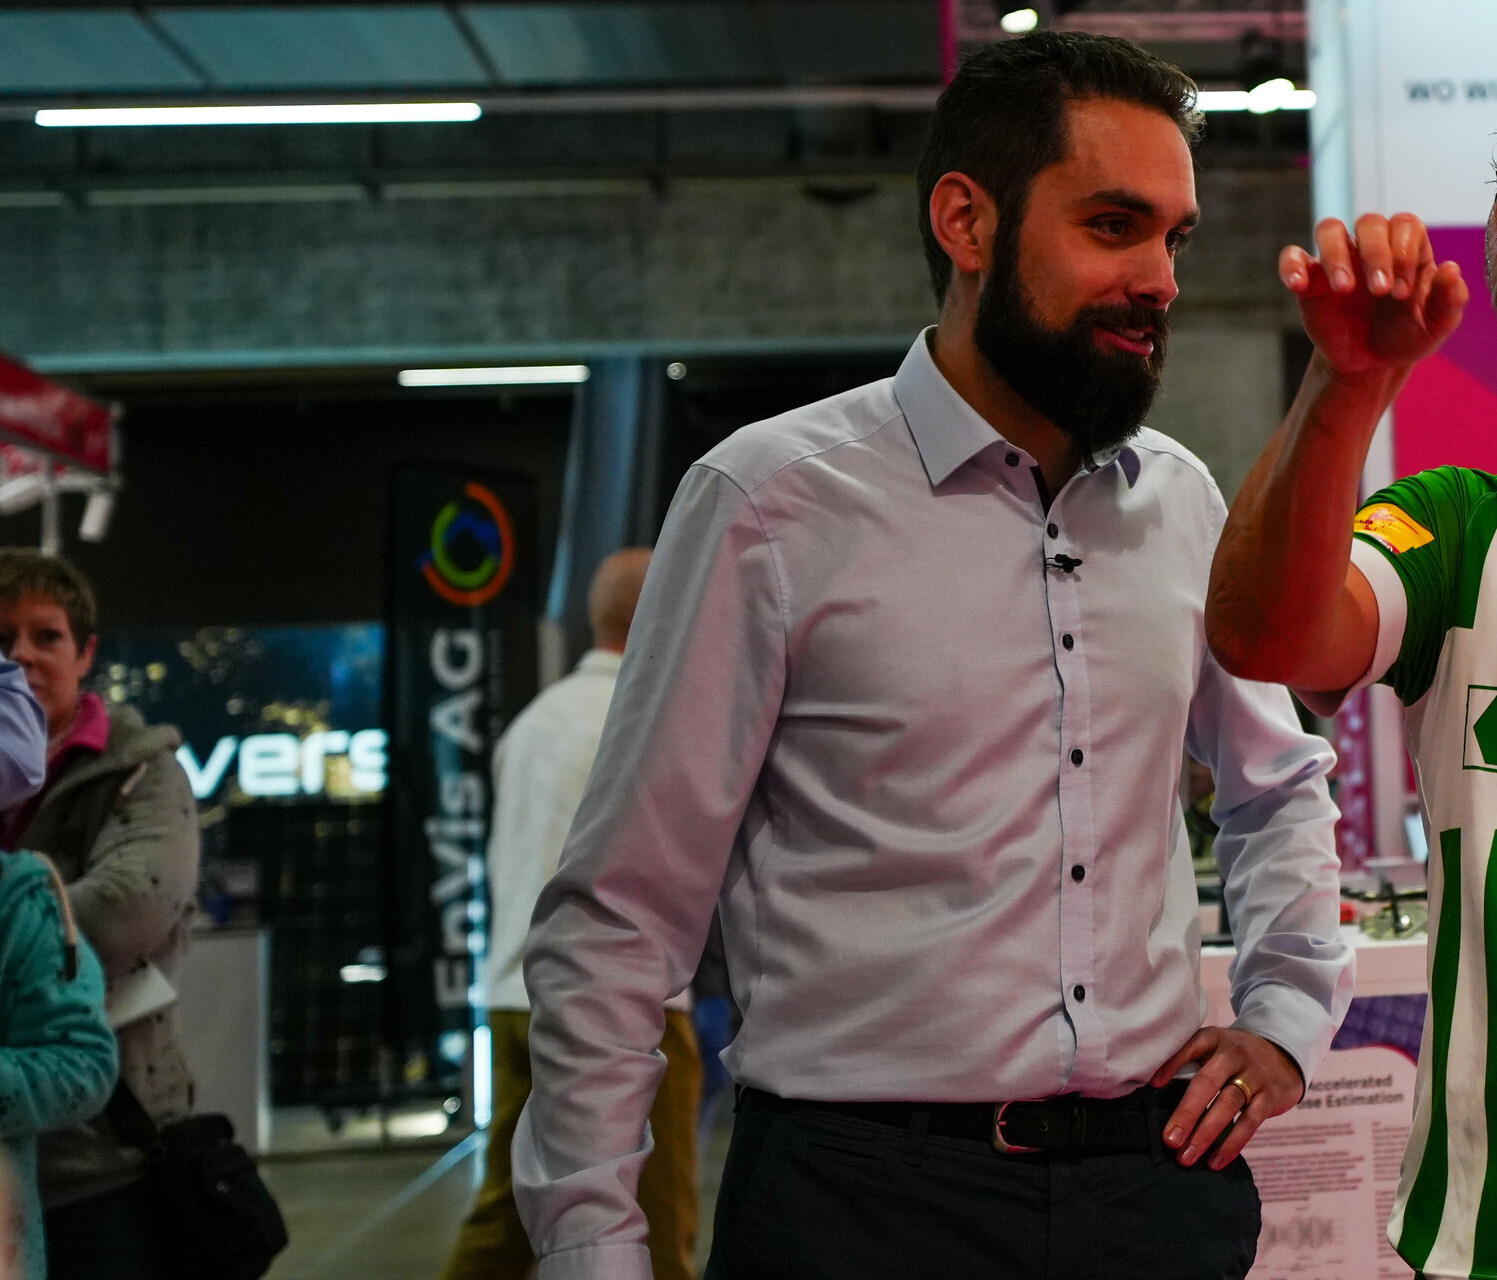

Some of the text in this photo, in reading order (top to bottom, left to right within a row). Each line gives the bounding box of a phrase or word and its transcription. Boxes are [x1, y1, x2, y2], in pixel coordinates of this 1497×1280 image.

[1405, 78, 1453, 101] WO
[430, 627, 483, 753] AG
[1308, 1074, 1393, 1091] Accelerated
[1326, 1091, 1404, 1108] Estimation
